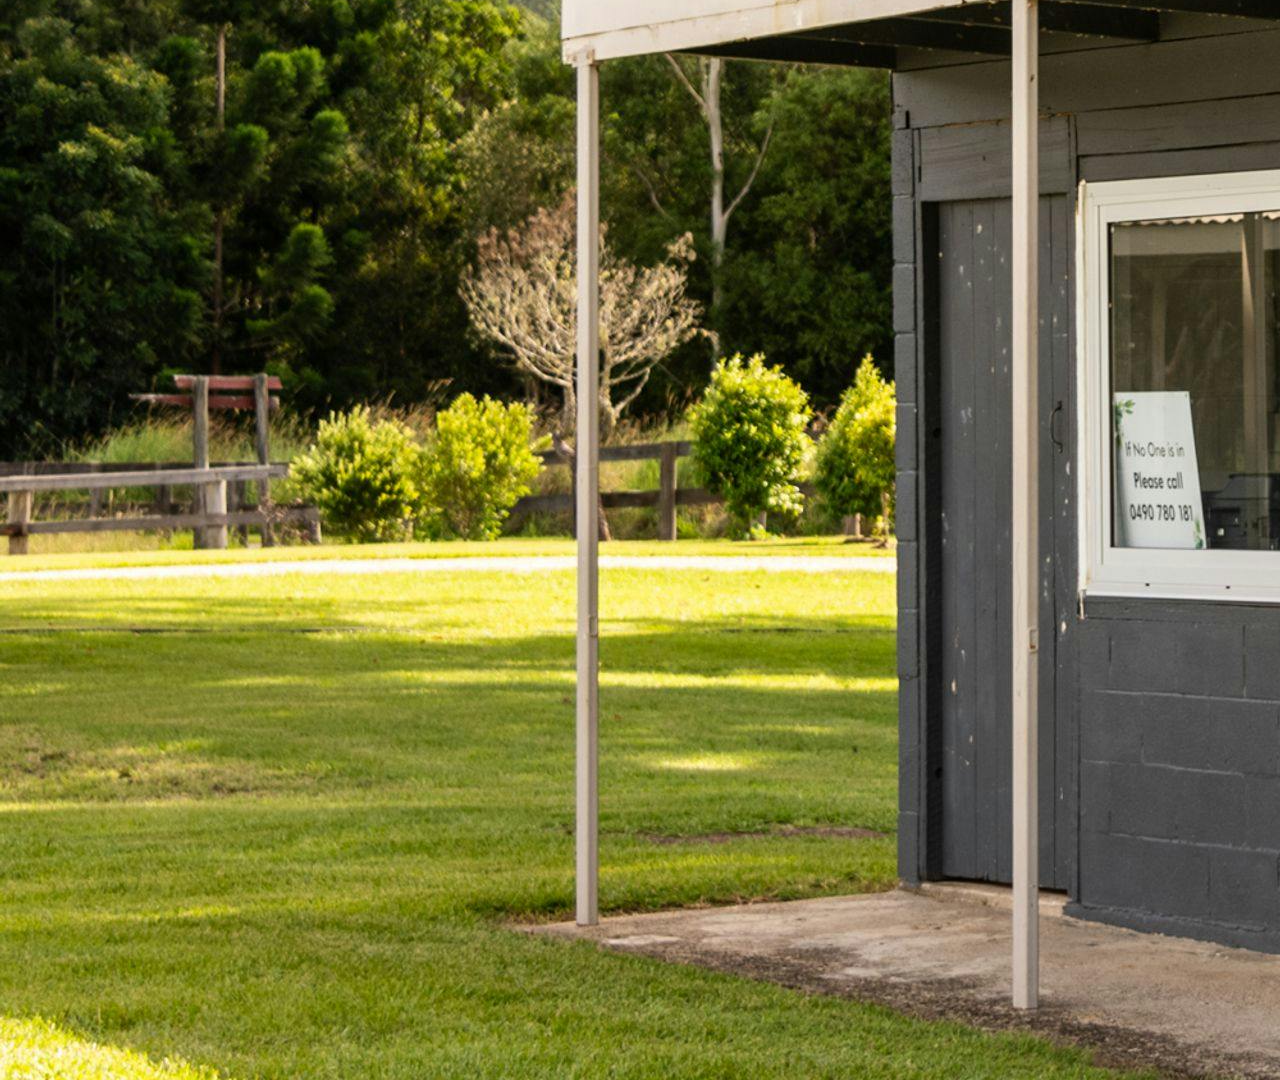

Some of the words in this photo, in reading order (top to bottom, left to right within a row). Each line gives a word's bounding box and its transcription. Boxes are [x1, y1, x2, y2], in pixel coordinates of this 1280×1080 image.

[1125, 441, 1132, 457] If
[1133, 442, 1146, 457] No
[1147, 442, 1166, 458] One
[1168, 442, 1175, 457] is
[1176, 442, 1185, 457] in
[1133, 471, 1164, 489] Please
[1167, 472, 1184, 489] call
[1129, 504, 1154, 520] 0490
[1157, 505, 1176, 521] 780
[1178, 505, 1193, 521] 181
